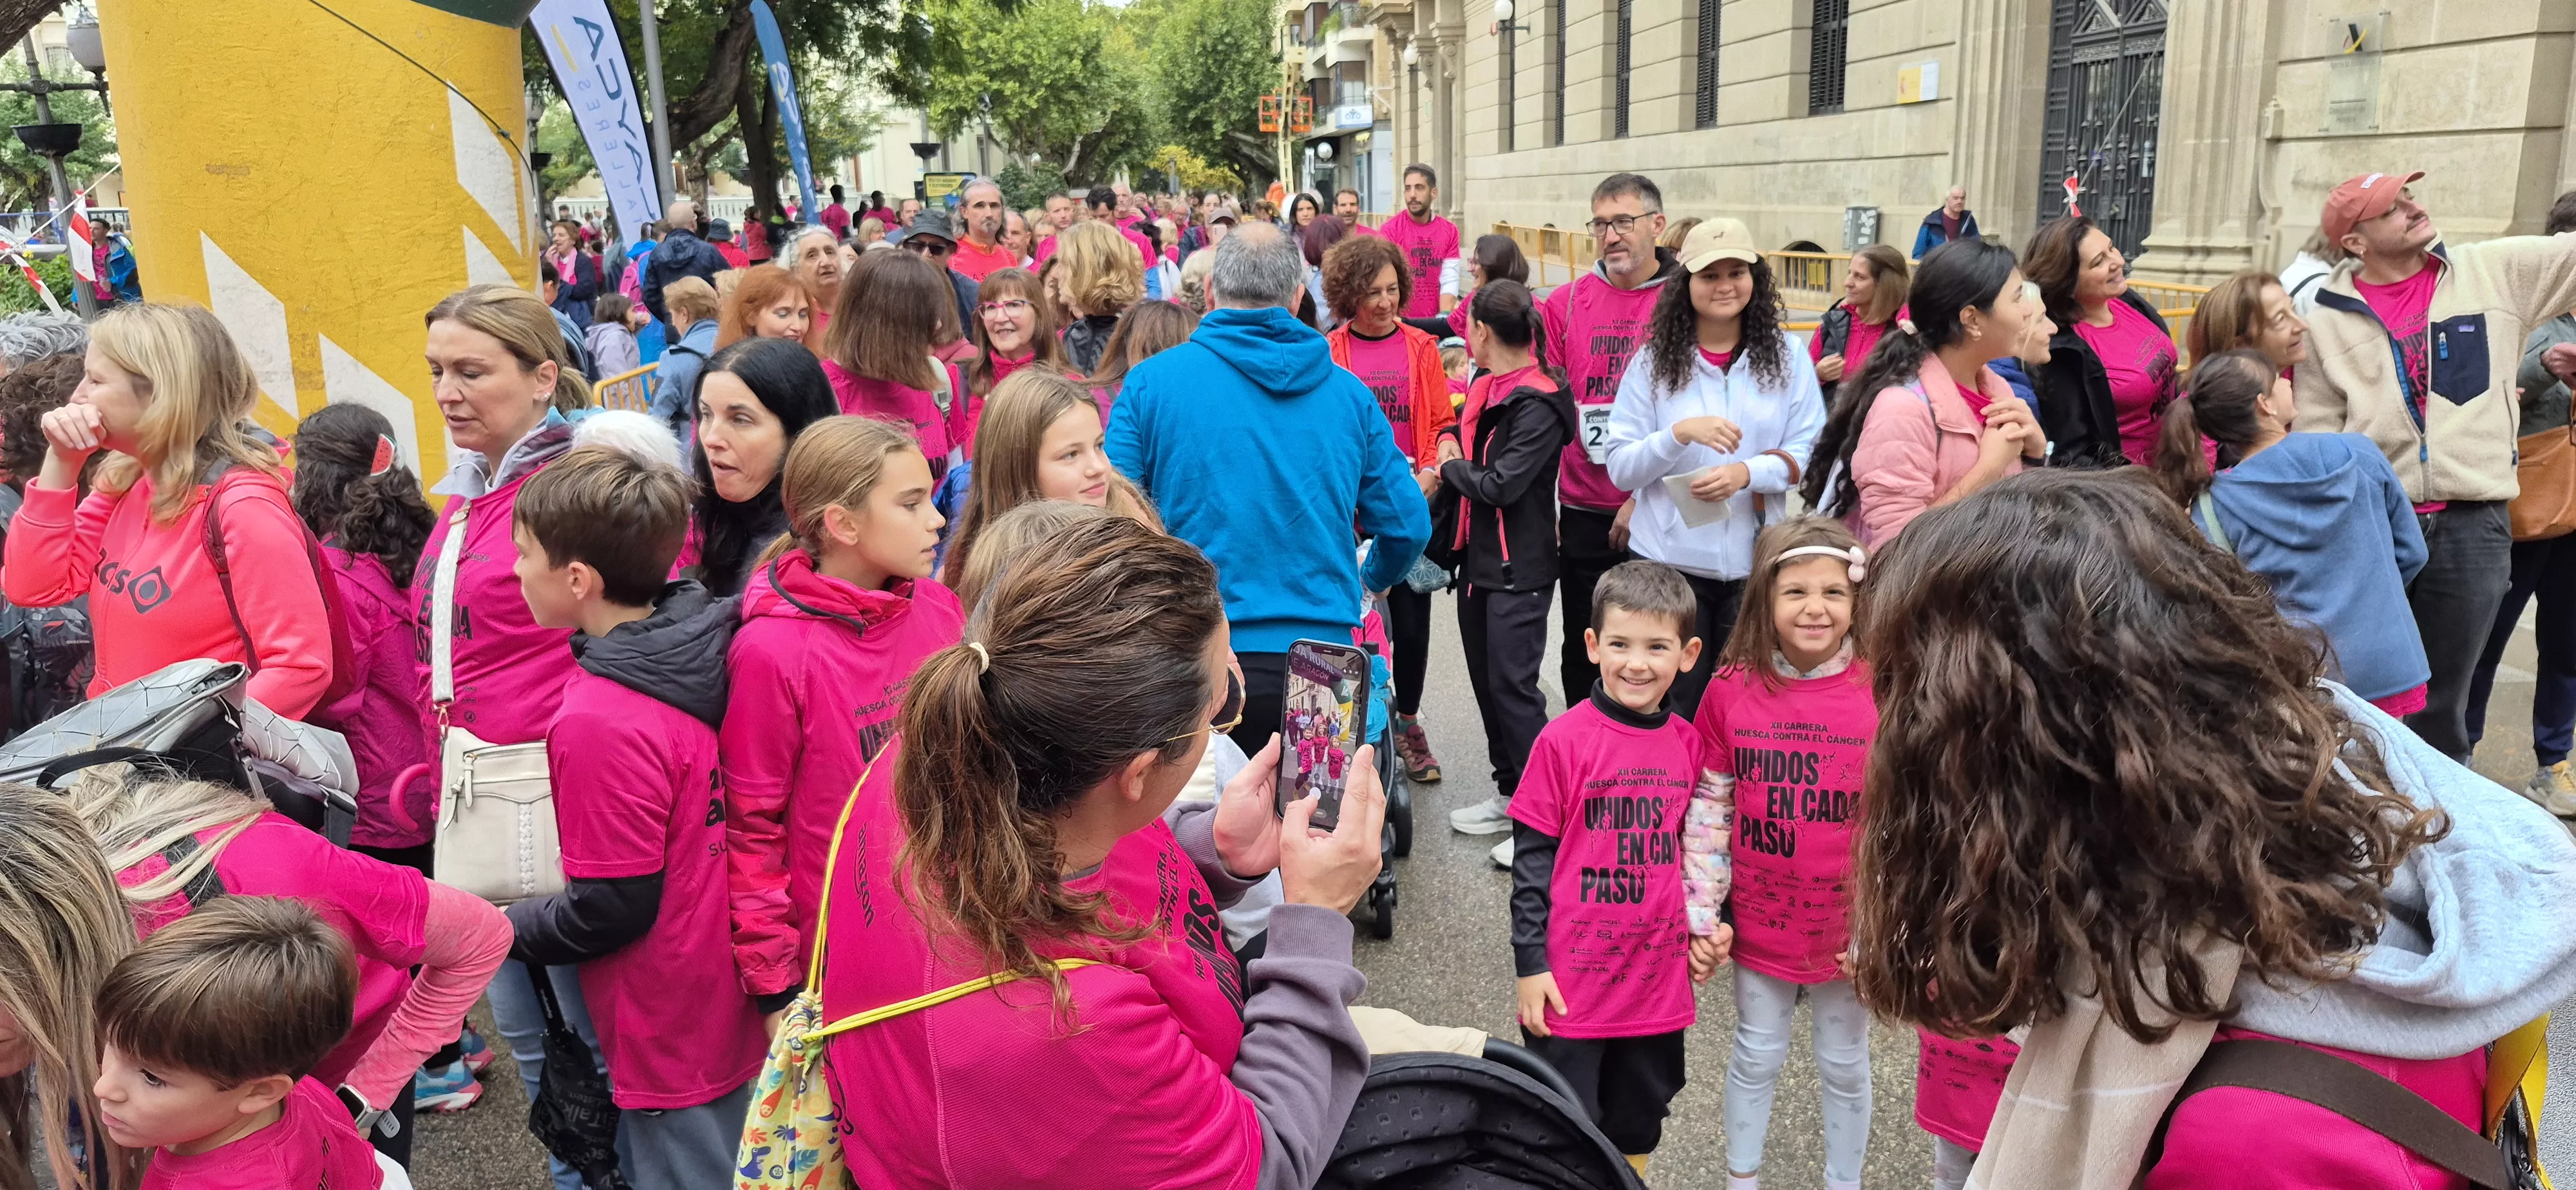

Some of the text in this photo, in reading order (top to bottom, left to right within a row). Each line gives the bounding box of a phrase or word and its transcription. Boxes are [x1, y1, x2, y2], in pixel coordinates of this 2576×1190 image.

[1590, 335, 1636, 355] UNIDOS
[1300, 661, 1330, 681] ARAGÓN
[1309, 652, 1335, 675] RURAL
[853, 700, 887, 718] HUESCA
[1734, 728, 1866, 746] HUESCA CONTRA EL CÁNCER
[1770, 721, 1828, 733] XII CARRERA
[1617, 768, 1667, 777] XII CARRERA
[1734, 746, 1820, 786] UNIDOS
[1585, 778, 1618, 789] HUESCA
[1621, 778, 1654, 787] CONTRA
[1667, 777, 1689, 789] CÁNCER
[1584, 795, 1664, 831] UNIDOS
[1766, 786, 1796, 820] EN
[1740, 814, 1796, 858] PASO
[1617, 831, 1645, 866] EN
[857, 821, 875, 929] amazon
[1168, 867, 1179, 885] EL
[1580, 867, 1645, 905] PASO
